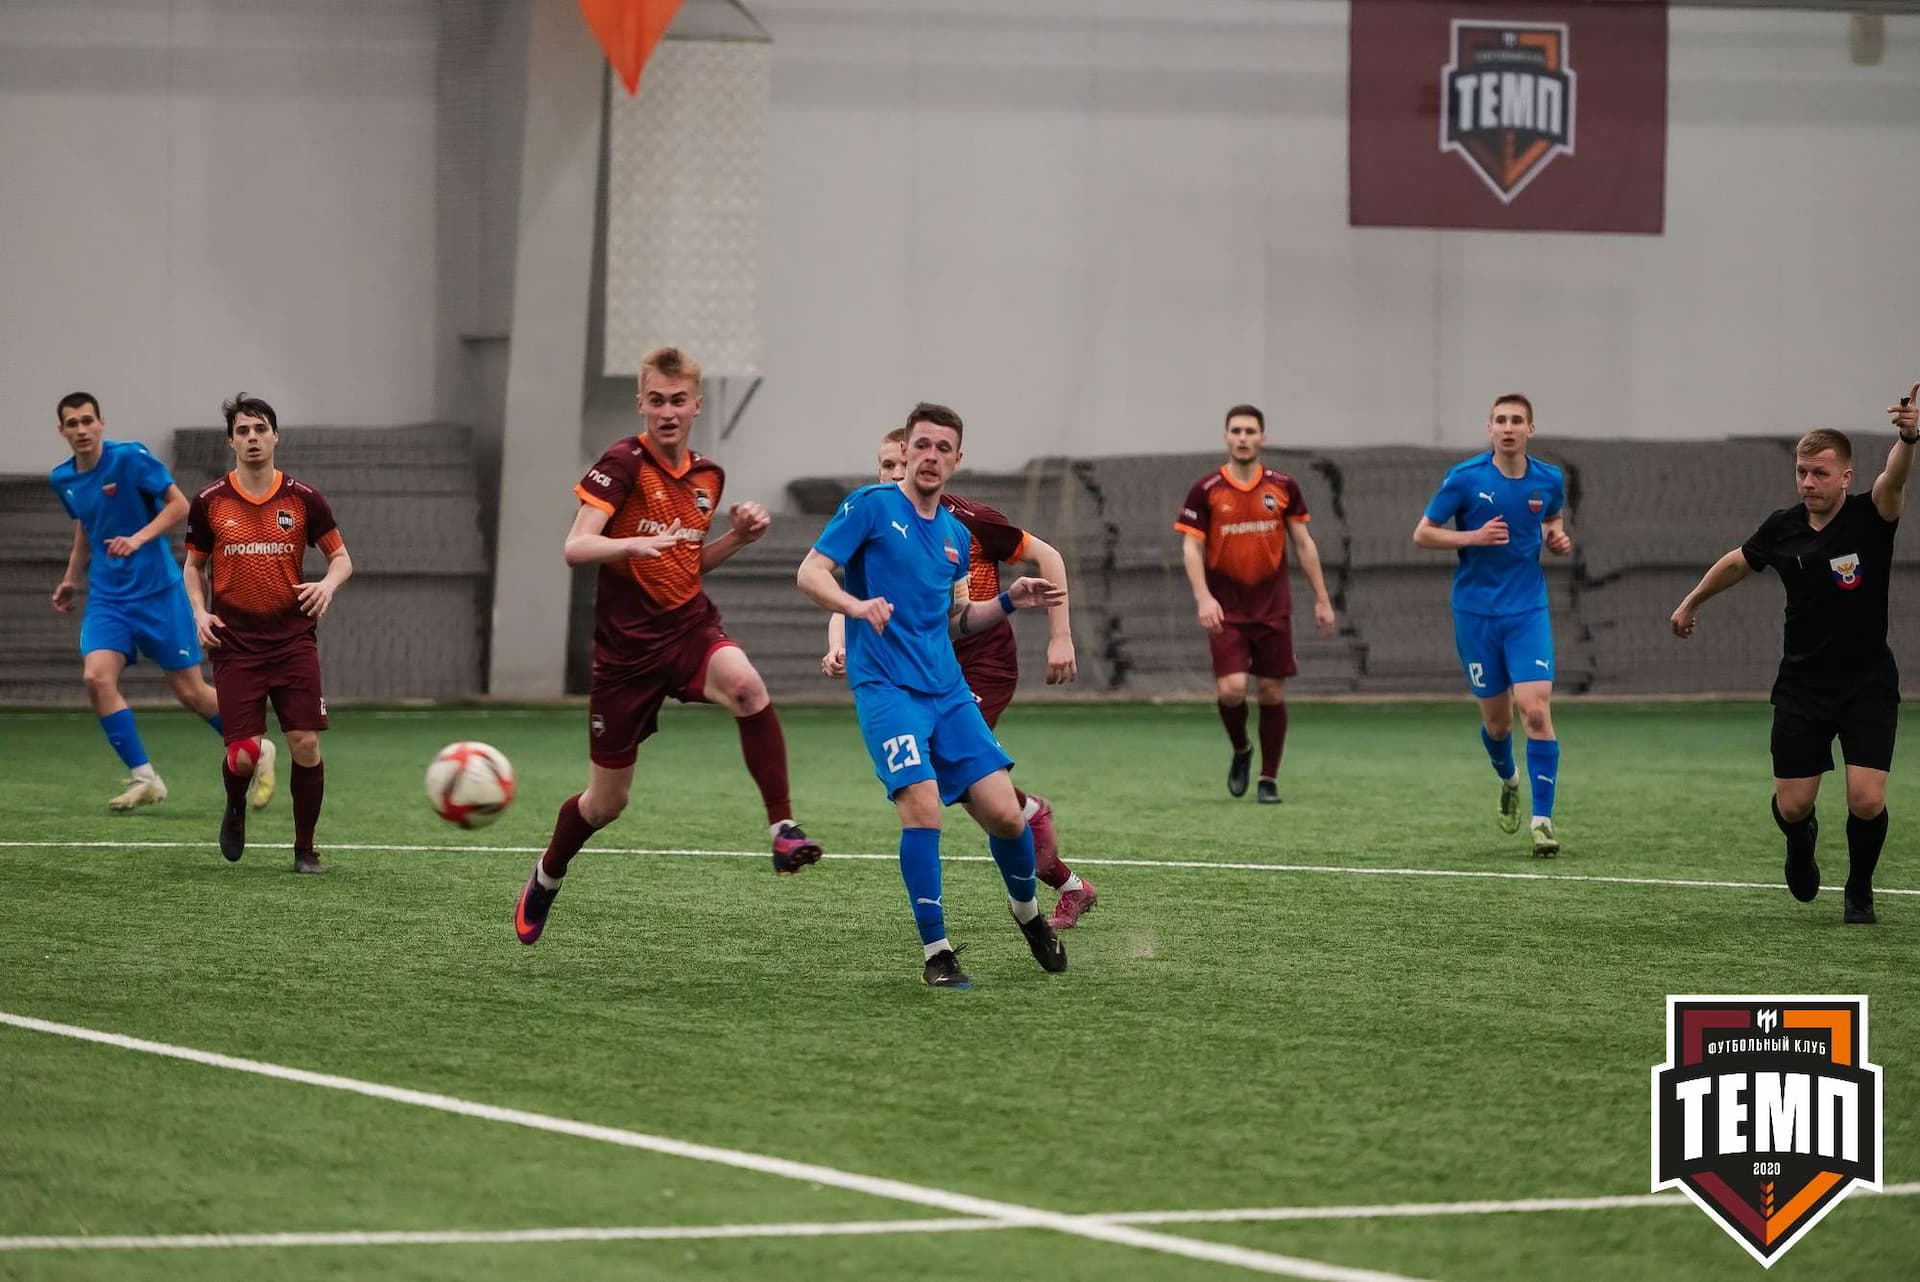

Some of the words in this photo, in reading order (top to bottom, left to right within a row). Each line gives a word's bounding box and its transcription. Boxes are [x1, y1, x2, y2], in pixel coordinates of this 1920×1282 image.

[1455, 72, 1562, 134] ТЕМП
[588, 469, 612, 487] ПСБ
[1469, 662, 1486, 688] 12
[882, 734, 921, 773] 23
